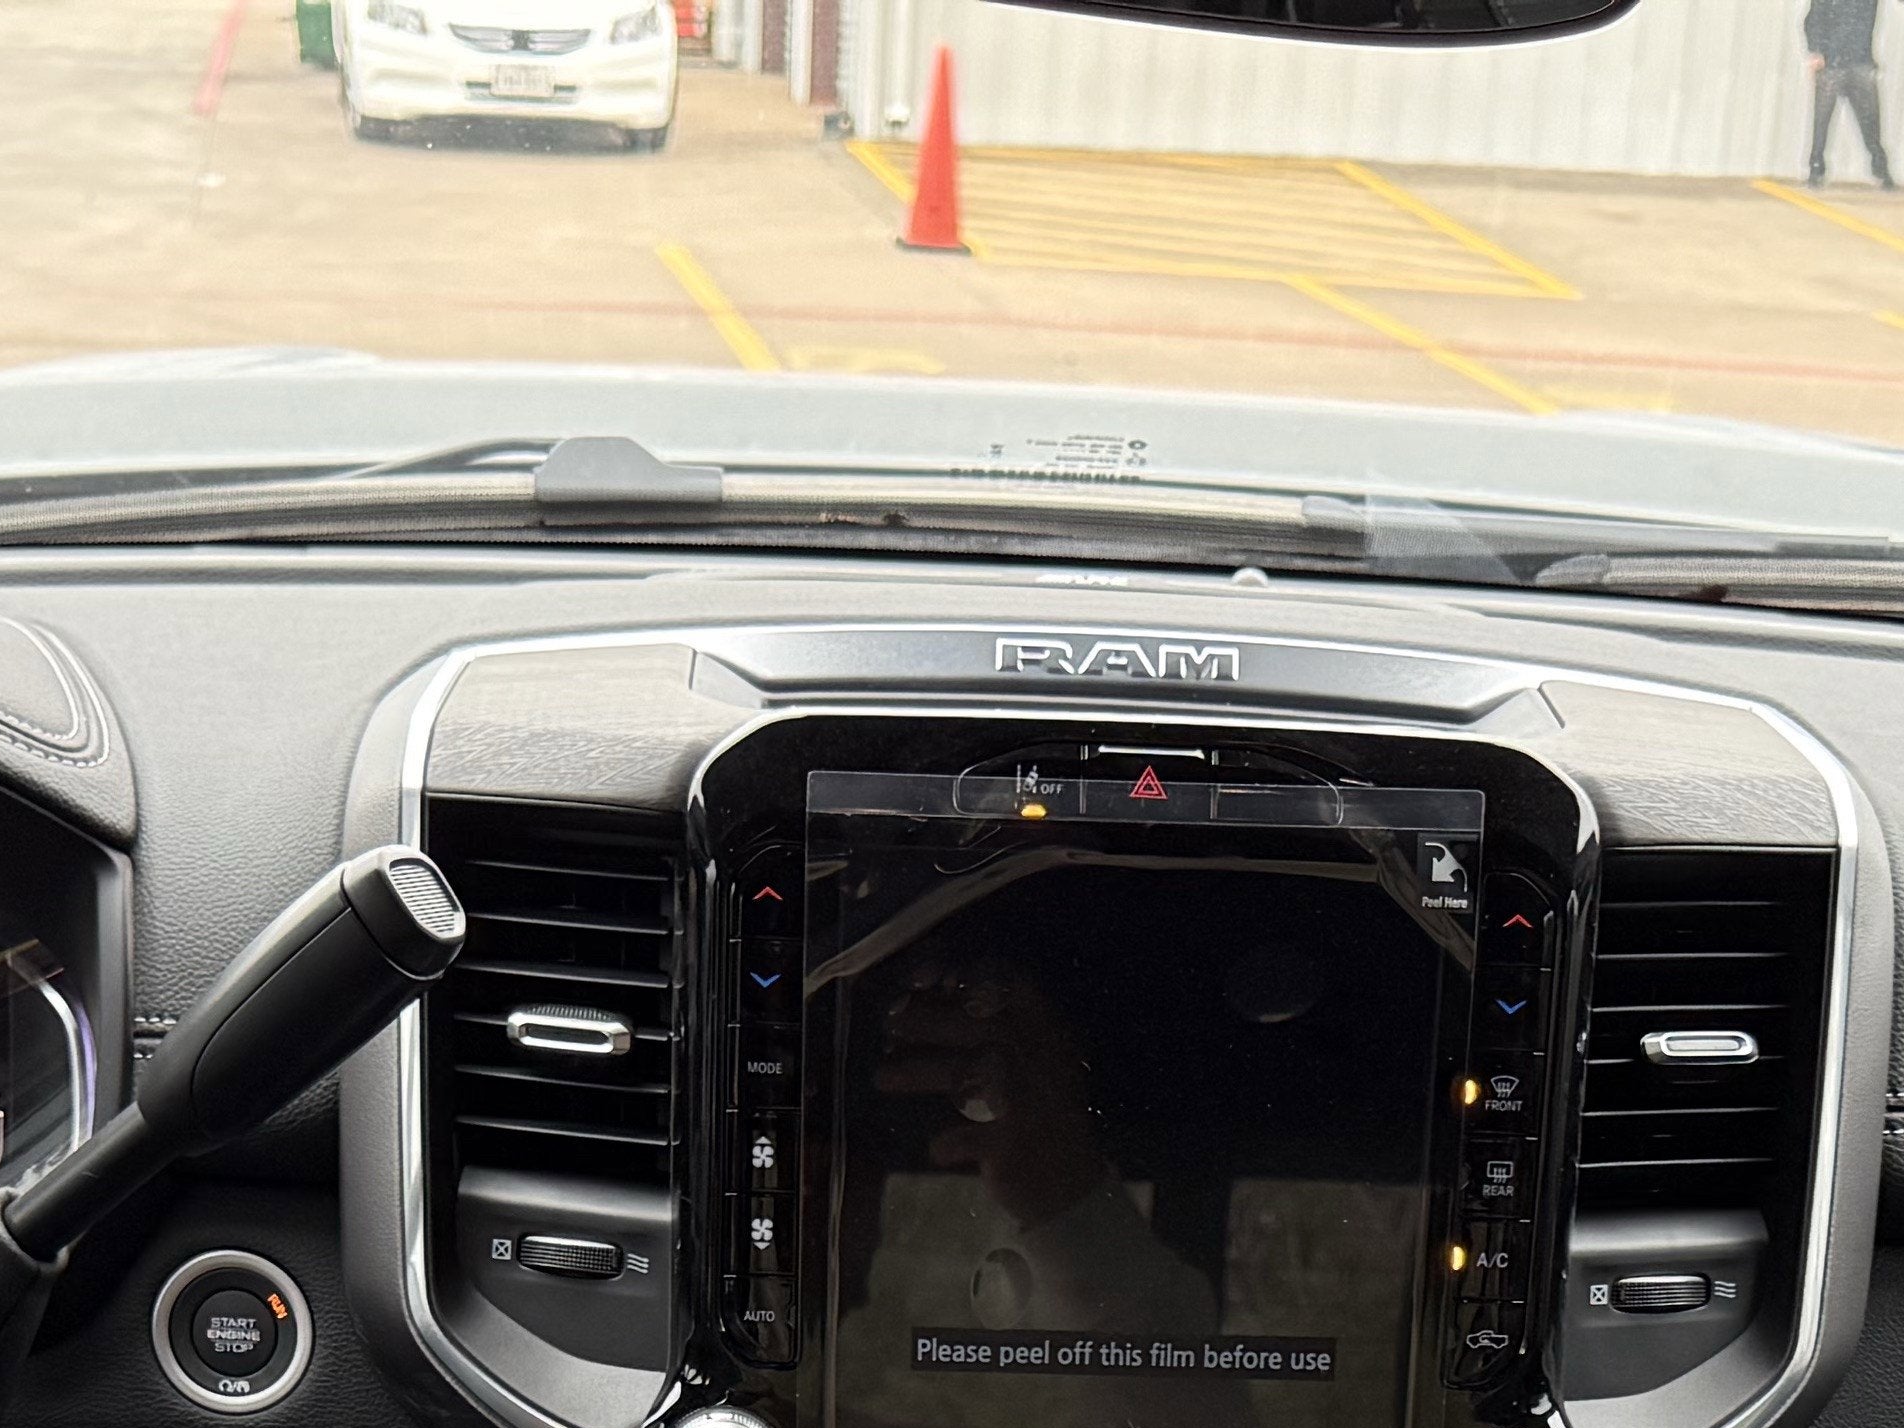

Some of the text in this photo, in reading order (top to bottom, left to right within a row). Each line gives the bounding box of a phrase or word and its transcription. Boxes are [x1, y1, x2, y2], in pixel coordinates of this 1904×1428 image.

[996, 637, 1240, 681] RAM
[1041, 783, 1063, 795] OFF
[747, 1061, 783, 1075] MODE
[1485, 1100, 1522, 1112] FRONT
[1483, 1185, 1514, 1197] REAR
[1476, 1253, 1509, 1268] A/C
[744, 1310, 775, 1323] AUTO
[211, 1318, 257, 1328] START
[207, 1330, 260, 1341] ENGINE
[215, 1343, 253, 1353] STOP
[917, 1338, 1331, 1371] Please peel off this film before use
